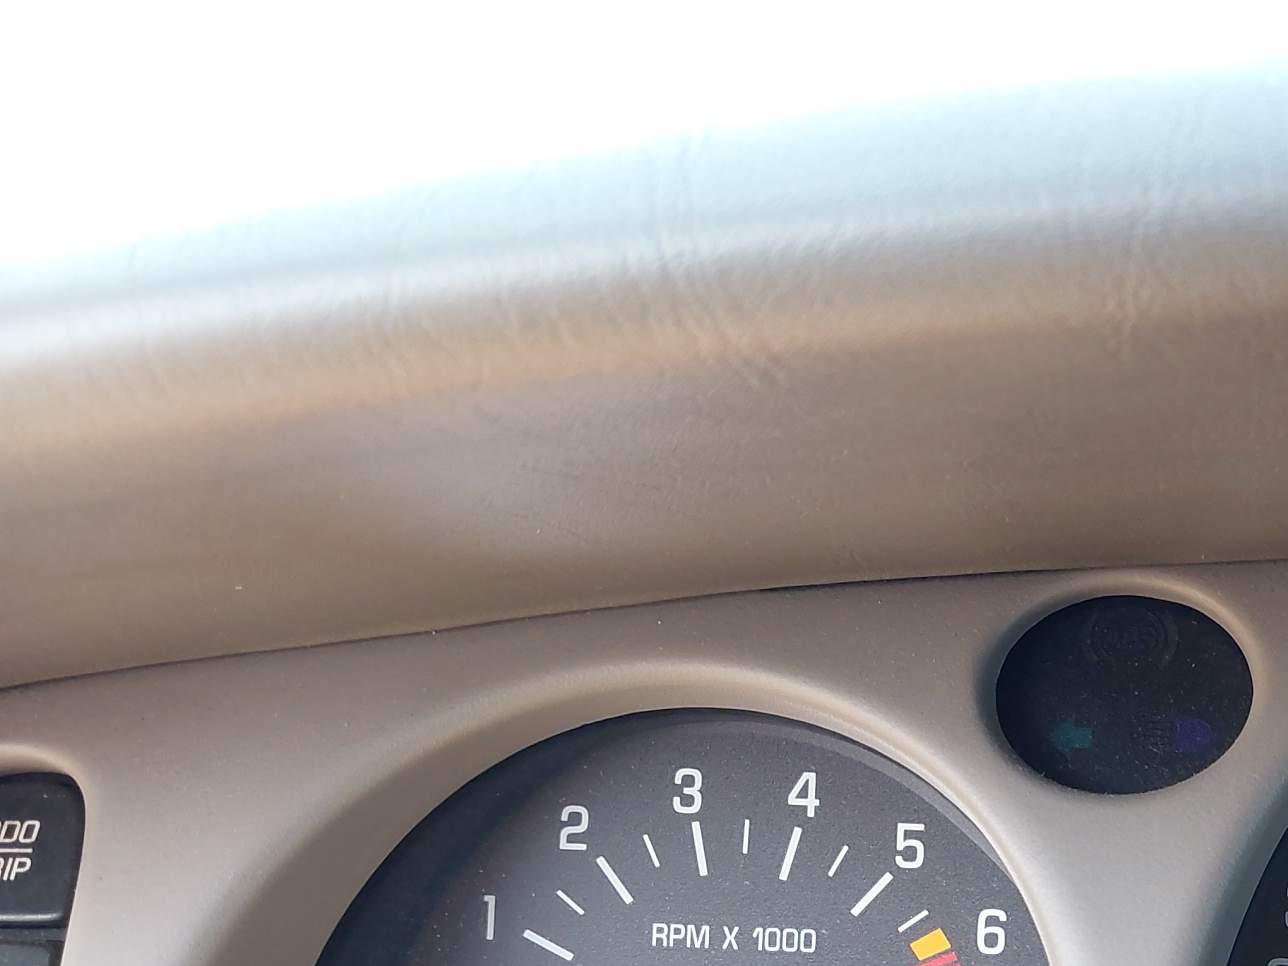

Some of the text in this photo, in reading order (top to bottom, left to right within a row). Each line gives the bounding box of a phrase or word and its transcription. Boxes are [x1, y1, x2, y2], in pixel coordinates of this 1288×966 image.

[672, 768, 702, 814] 3
[787, 772, 820, 818] 4
[0, 820, 40, 843] DO
[559, 805, 589, 851] 2
[894, 823, 926, 869] 5
[484, 895, 496, 940] 1
[651, 923, 816, 953] RPM X 1000
[976, 909, 1006, 955] 6
